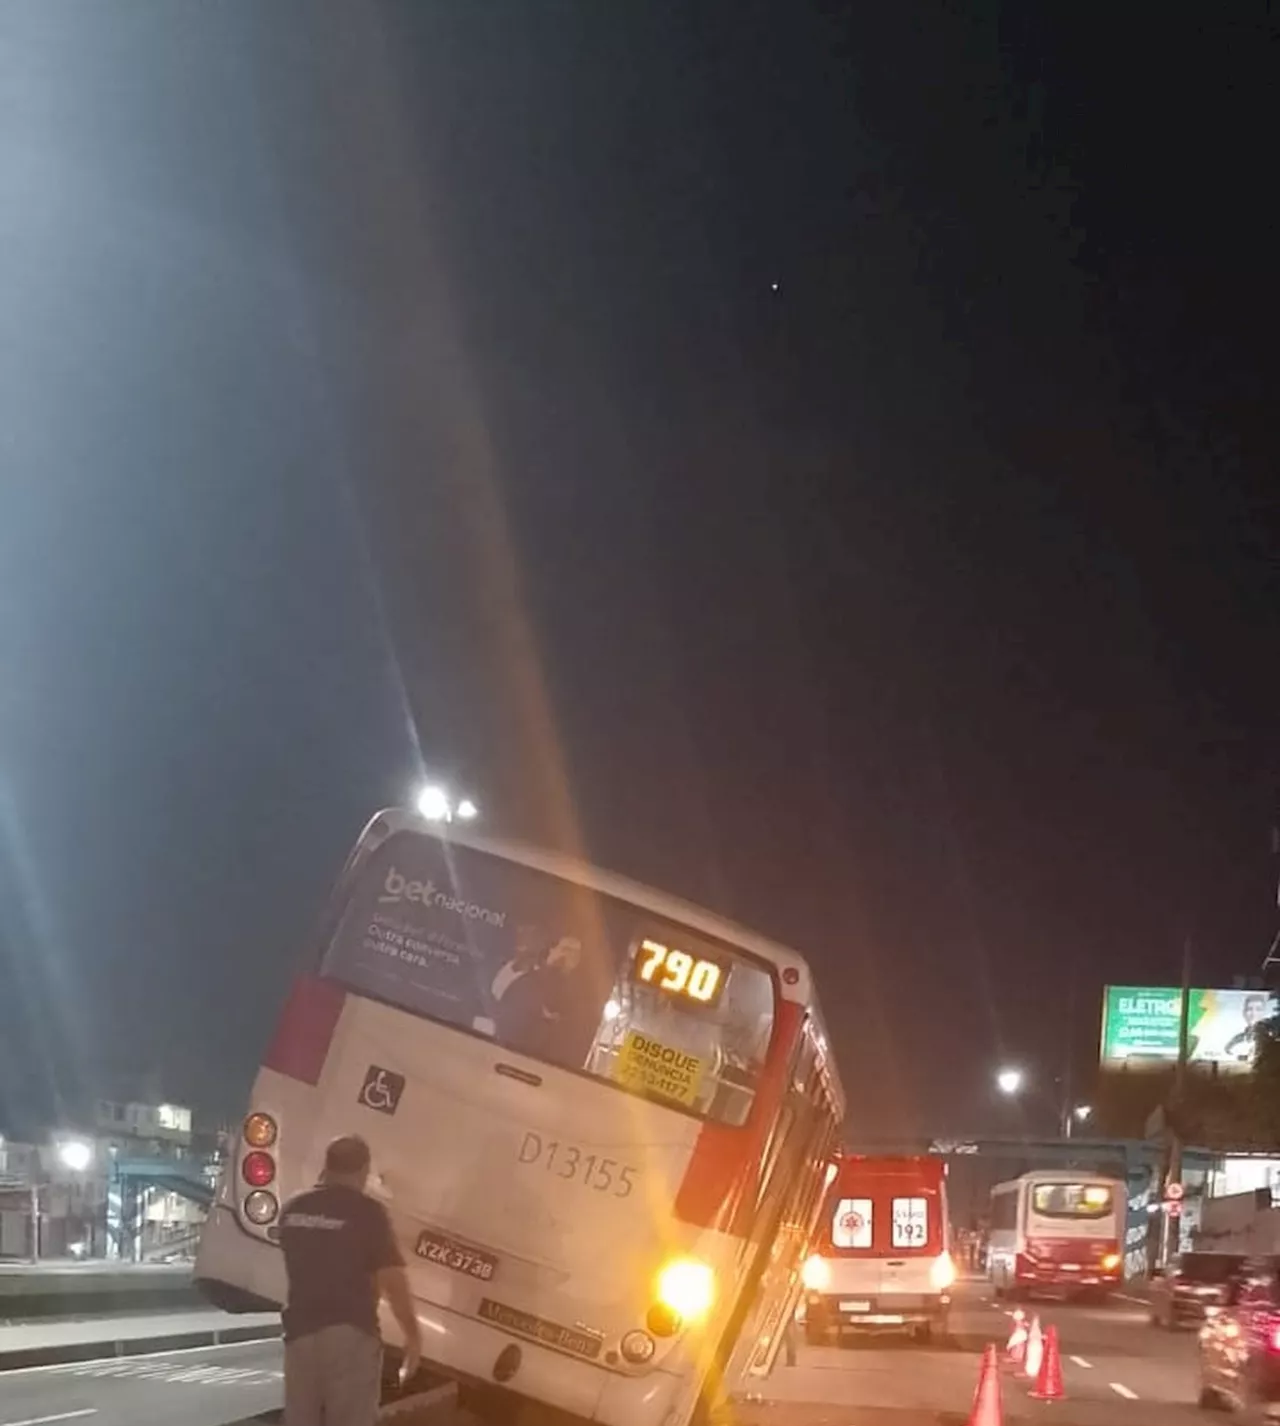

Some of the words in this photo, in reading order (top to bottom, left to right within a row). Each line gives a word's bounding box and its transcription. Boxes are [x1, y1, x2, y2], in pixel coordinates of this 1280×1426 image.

[379, 866, 506, 928] betnacional
[641, 940, 721, 1001] 790
[632, 1035, 699, 1074] DISQUE
[518, 1131, 638, 1198] D13155
[416, 1239, 449, 1265] KZK
[896, 1223, 924, 1240] 192
